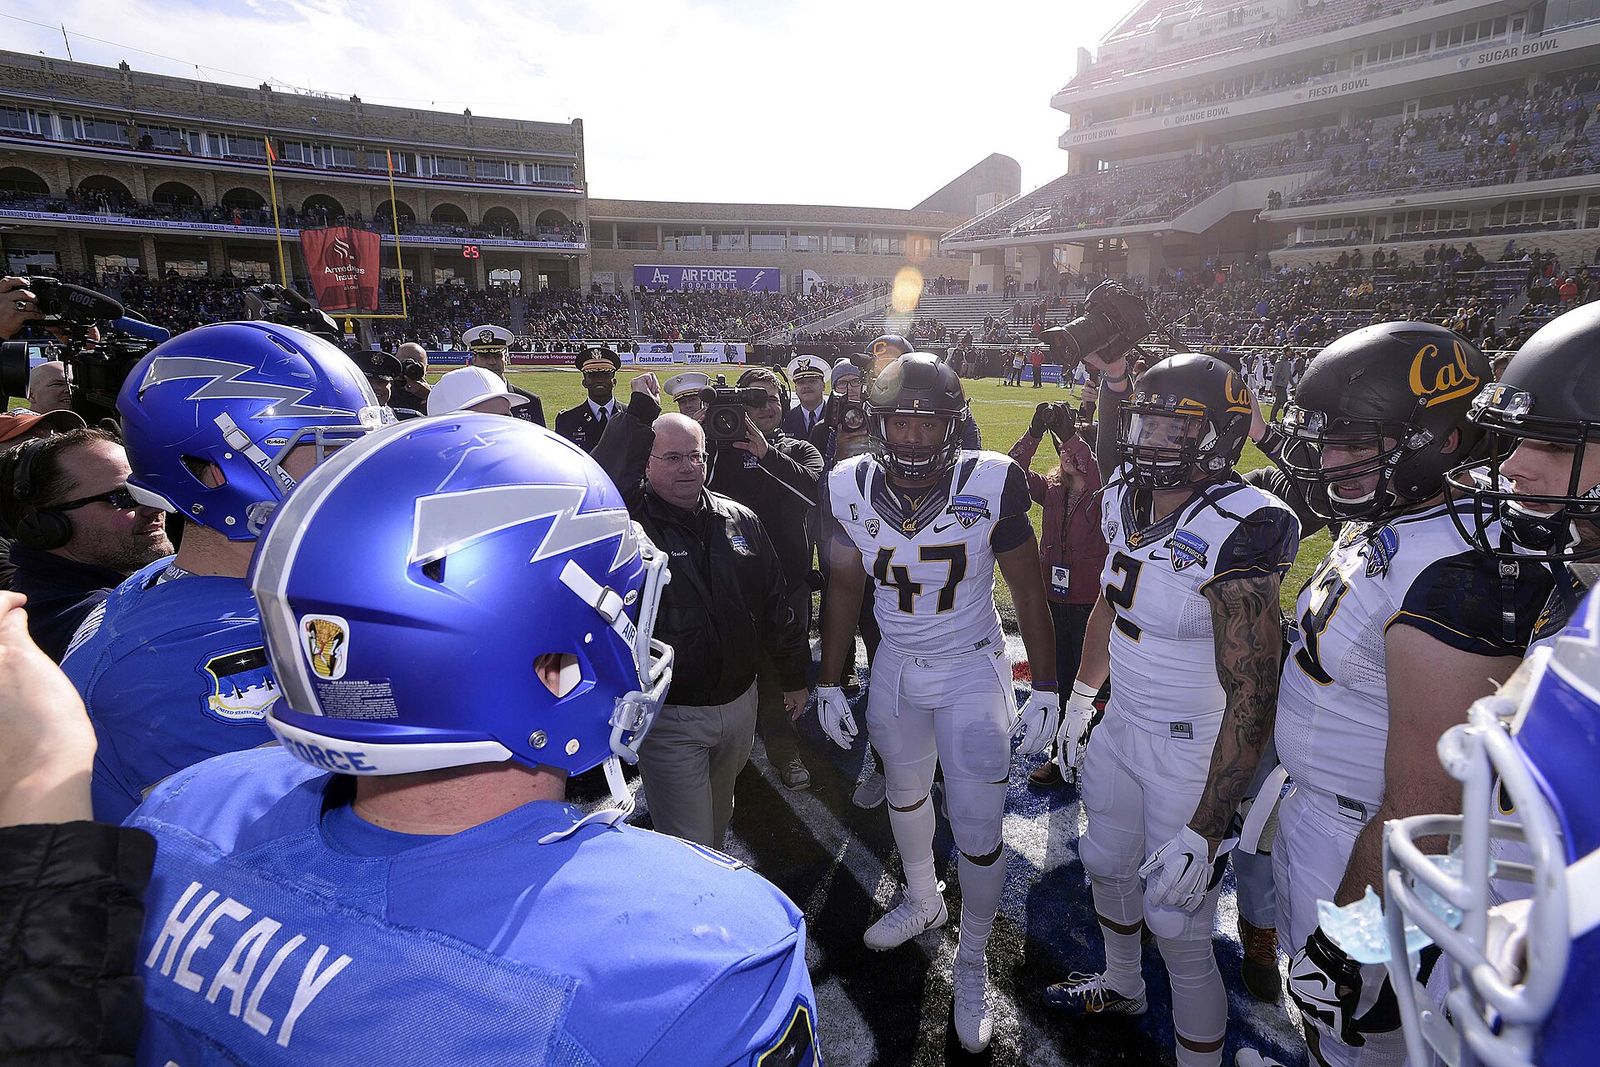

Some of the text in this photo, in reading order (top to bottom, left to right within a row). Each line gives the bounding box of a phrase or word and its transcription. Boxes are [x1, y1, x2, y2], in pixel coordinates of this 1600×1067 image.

[1478, 39, 1559, 65] SUGAR BOWL
[1308, 79, 1370, 99] FIESTA BOWL
[1175, 107, 1230, 125] ORANGE BOWL
[1072, 129, 1118, 143] COTTON BOWL
[463, 245, 479, 258] 25
[681, 269, 737, 282] AIR FORCE
[1410, 340, 1480, 408] Cal
[1225, 369, 1252, 414] Ca
[902, 518, 917, 532] Cal
[873, 542, 967, 615] 47
[1105, 550, 1143, 644] 2
[622, 622, 636, 645] AIR
[215, 705, 234, 715] UNITED
[145, 881, 353, 1048] HEALY
